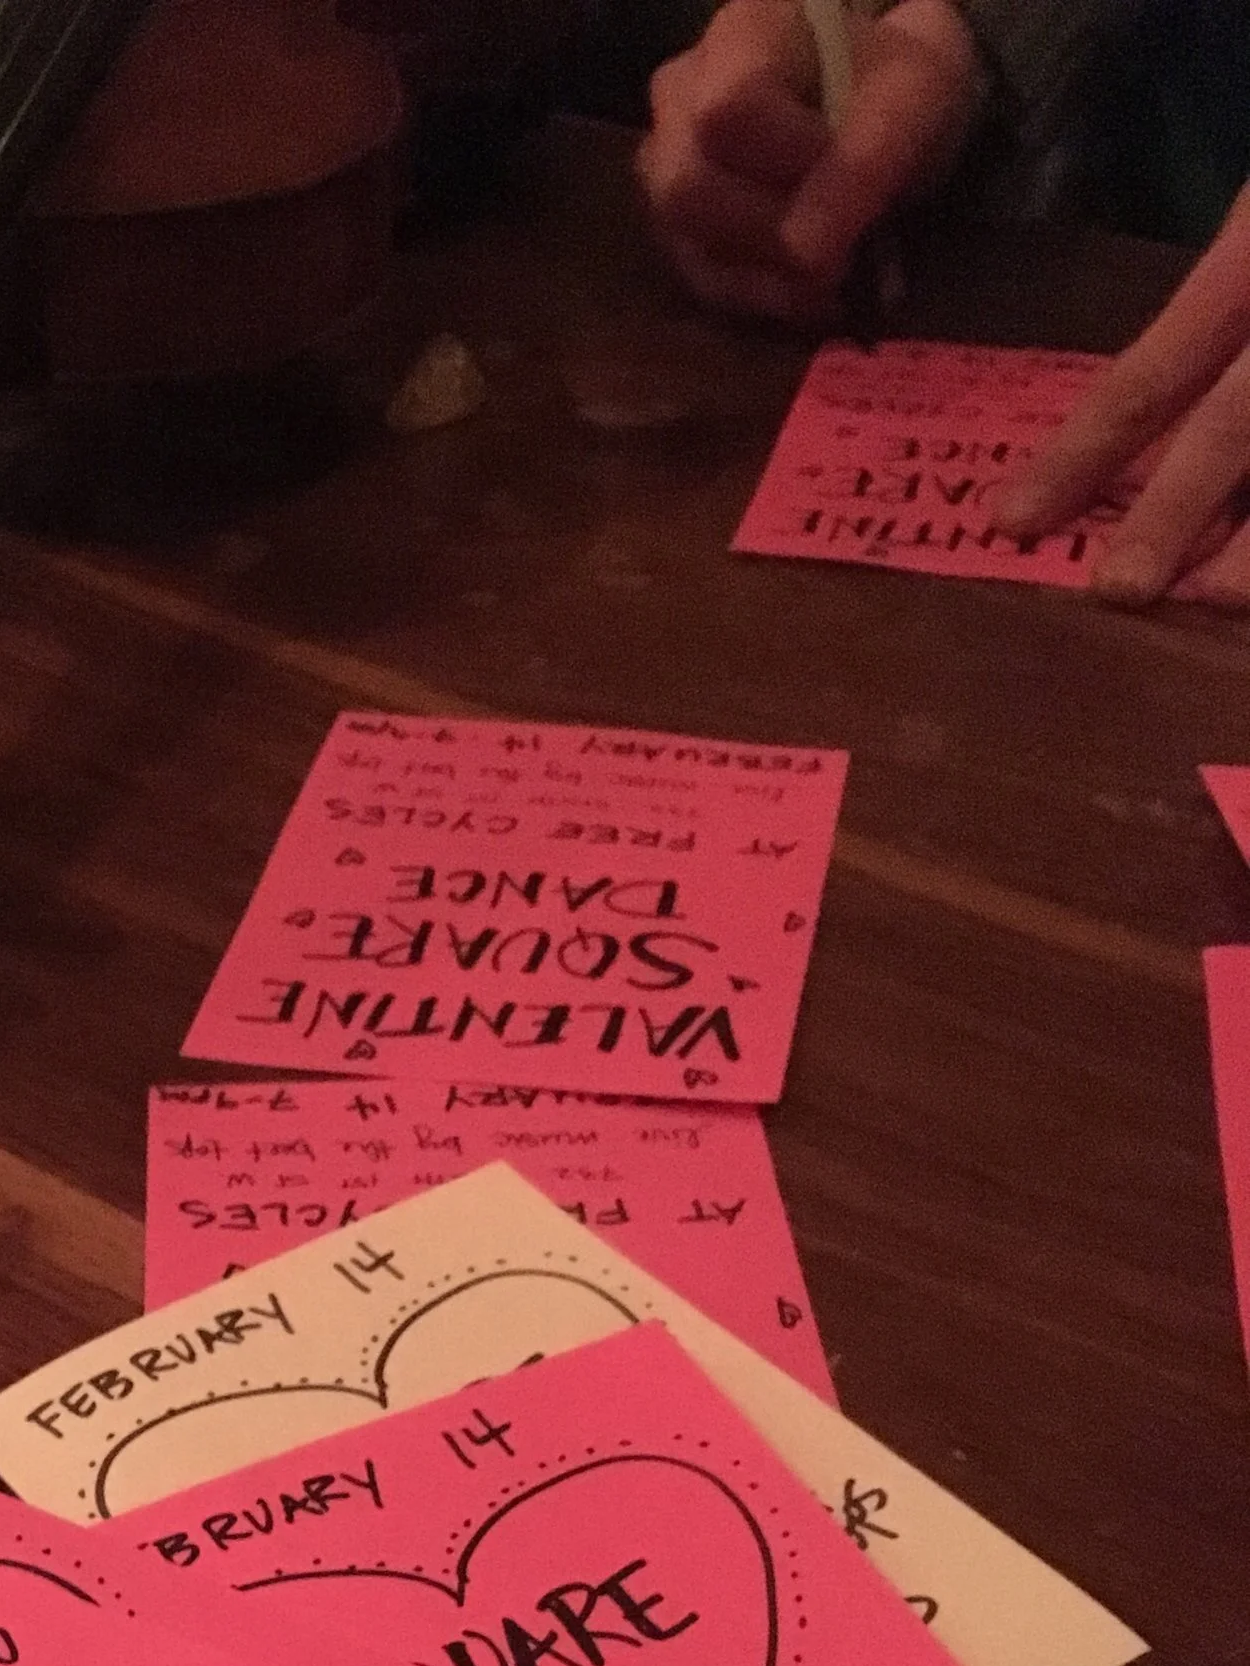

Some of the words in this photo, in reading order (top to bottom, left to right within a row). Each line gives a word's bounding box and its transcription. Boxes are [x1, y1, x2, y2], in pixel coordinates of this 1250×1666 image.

[579, 735, 822, 775] FEBRUARY
[323, 798, 519, 835] CYCLES
[546, 820, 697, 853] FREE
[738, 838, 798, 858] AT
[386, 865, 686, 920] DANCE
[302, 910, 720, 991] SQUARE
[236, 978, 741, 1062] VALENTINE
[347, 1093, 398, 1121] 14
[177, 1199, 393, 1231] YCLES
[677, 1198, 747, 1227] AT
[26, 1293, 295, 1438] FEBRUARY
[334, 1240, 406, 1293] 14
[154, 1459, 383, 1567] BRUARY
[442, 1408, 516, 1469] 14
